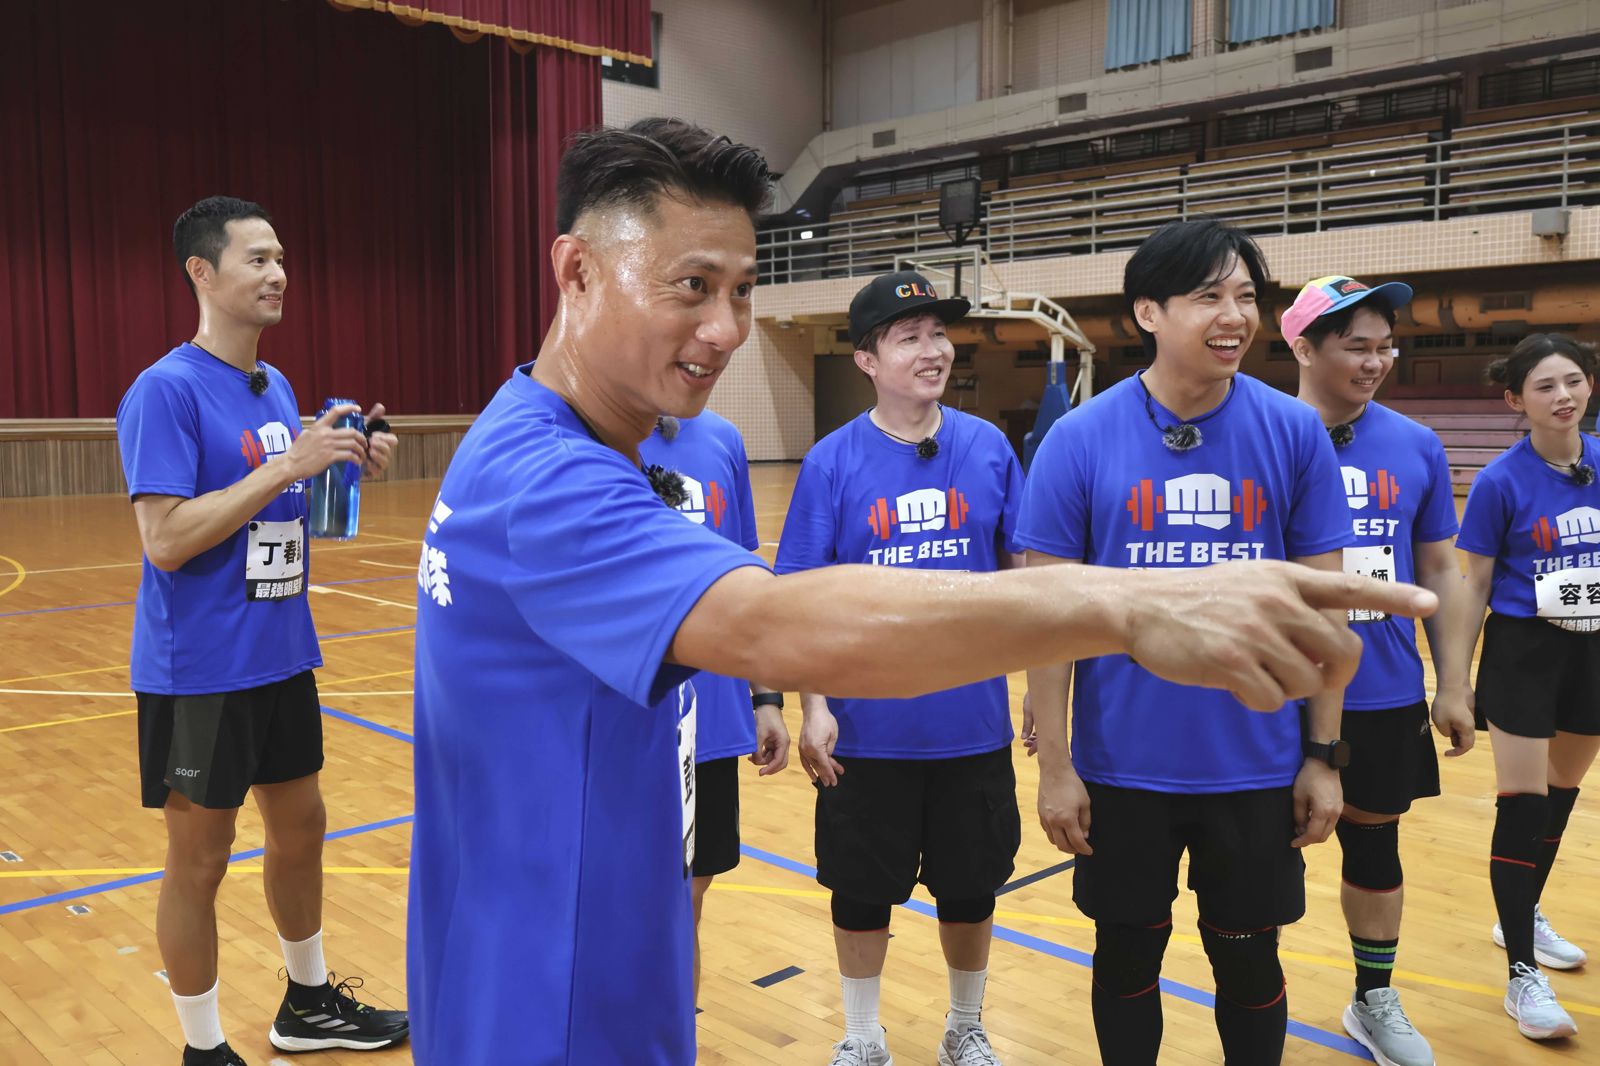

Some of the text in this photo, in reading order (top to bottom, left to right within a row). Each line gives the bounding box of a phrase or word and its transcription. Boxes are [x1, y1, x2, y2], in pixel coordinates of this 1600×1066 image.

[1352, 518, 1399, 537] EST
[868, 537, 970, 565] THE BEST
[1126, 541, 1264, 563] THE BEST
[1532, 555, 1573, 573] THE
[174, 767, 201, 777] soar
